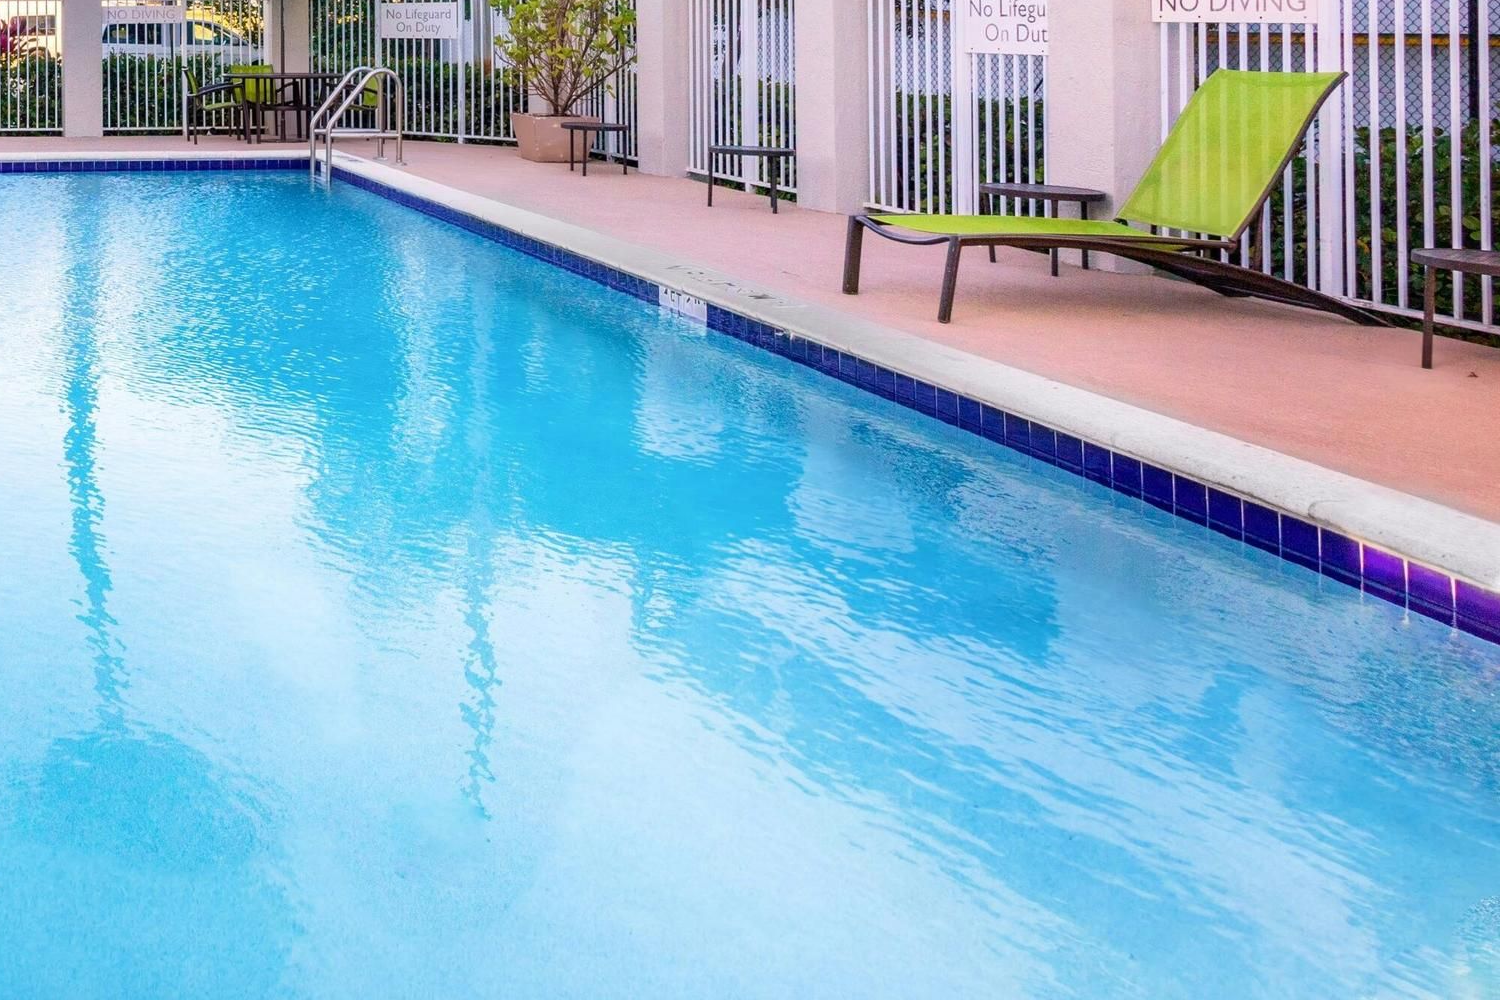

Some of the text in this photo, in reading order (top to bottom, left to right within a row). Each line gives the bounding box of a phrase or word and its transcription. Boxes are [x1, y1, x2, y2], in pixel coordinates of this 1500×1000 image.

[107, 9, 175, 19] NO DIVING
[386, 8, 451, 22] No Lifeguard
[969, 0, 993, 17] No
[396, 22, 441, 35] On Duty
[985, 24, 1048, 43] On Dut
